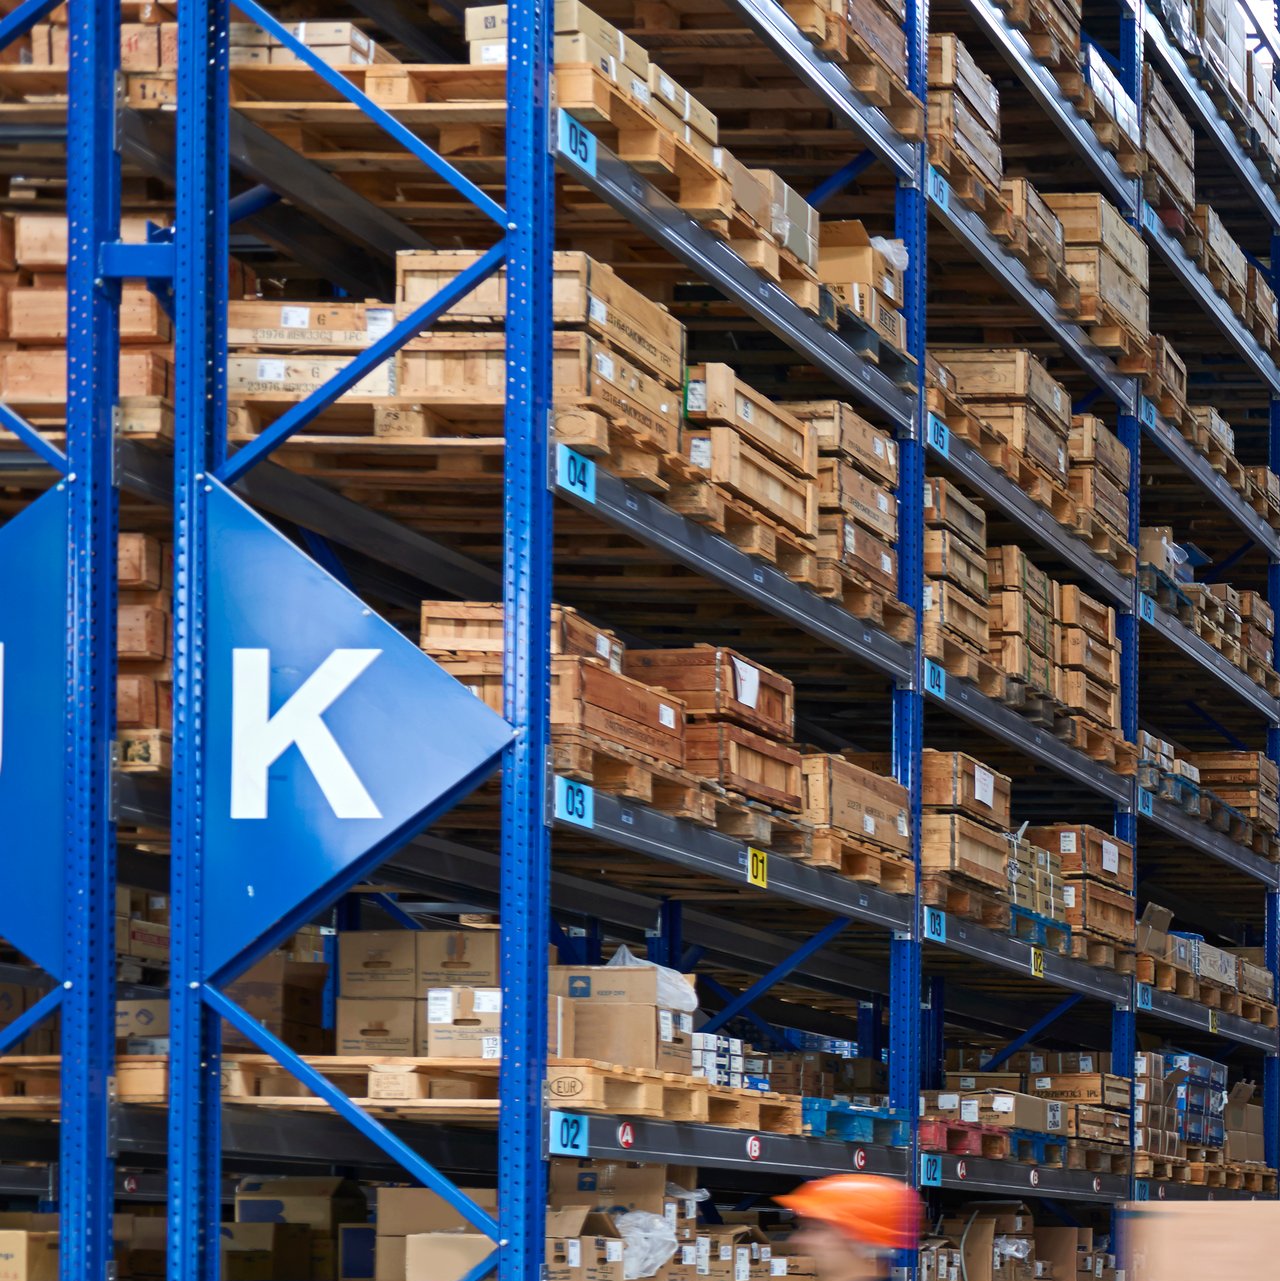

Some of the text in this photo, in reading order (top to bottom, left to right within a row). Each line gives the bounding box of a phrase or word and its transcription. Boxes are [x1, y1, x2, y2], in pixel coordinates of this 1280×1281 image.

[568, 123, 589, 163] 05
[932, 173, 945, 206] 06
[933, 421, 946, 451] 05
[567, 458, 588, 494] 04
[929, 666, 942, 692] 04
[231, 648, 383, 819] K
[565, 785, 586, 820] 03
[751, 852, 766, 882] 01
[930, 912, 943, 937] 03
[1033, 952, 1043, 974] 02
[557, 1080, 576, 1093] EUR
[560, 1117, 581, 1149] 02
[621, 1126, 634, 1142] A
[750, 1140, 761, 1156] B
[858, 1151, 865, 1166] C
[926, 1157, 938, 1182] 02
